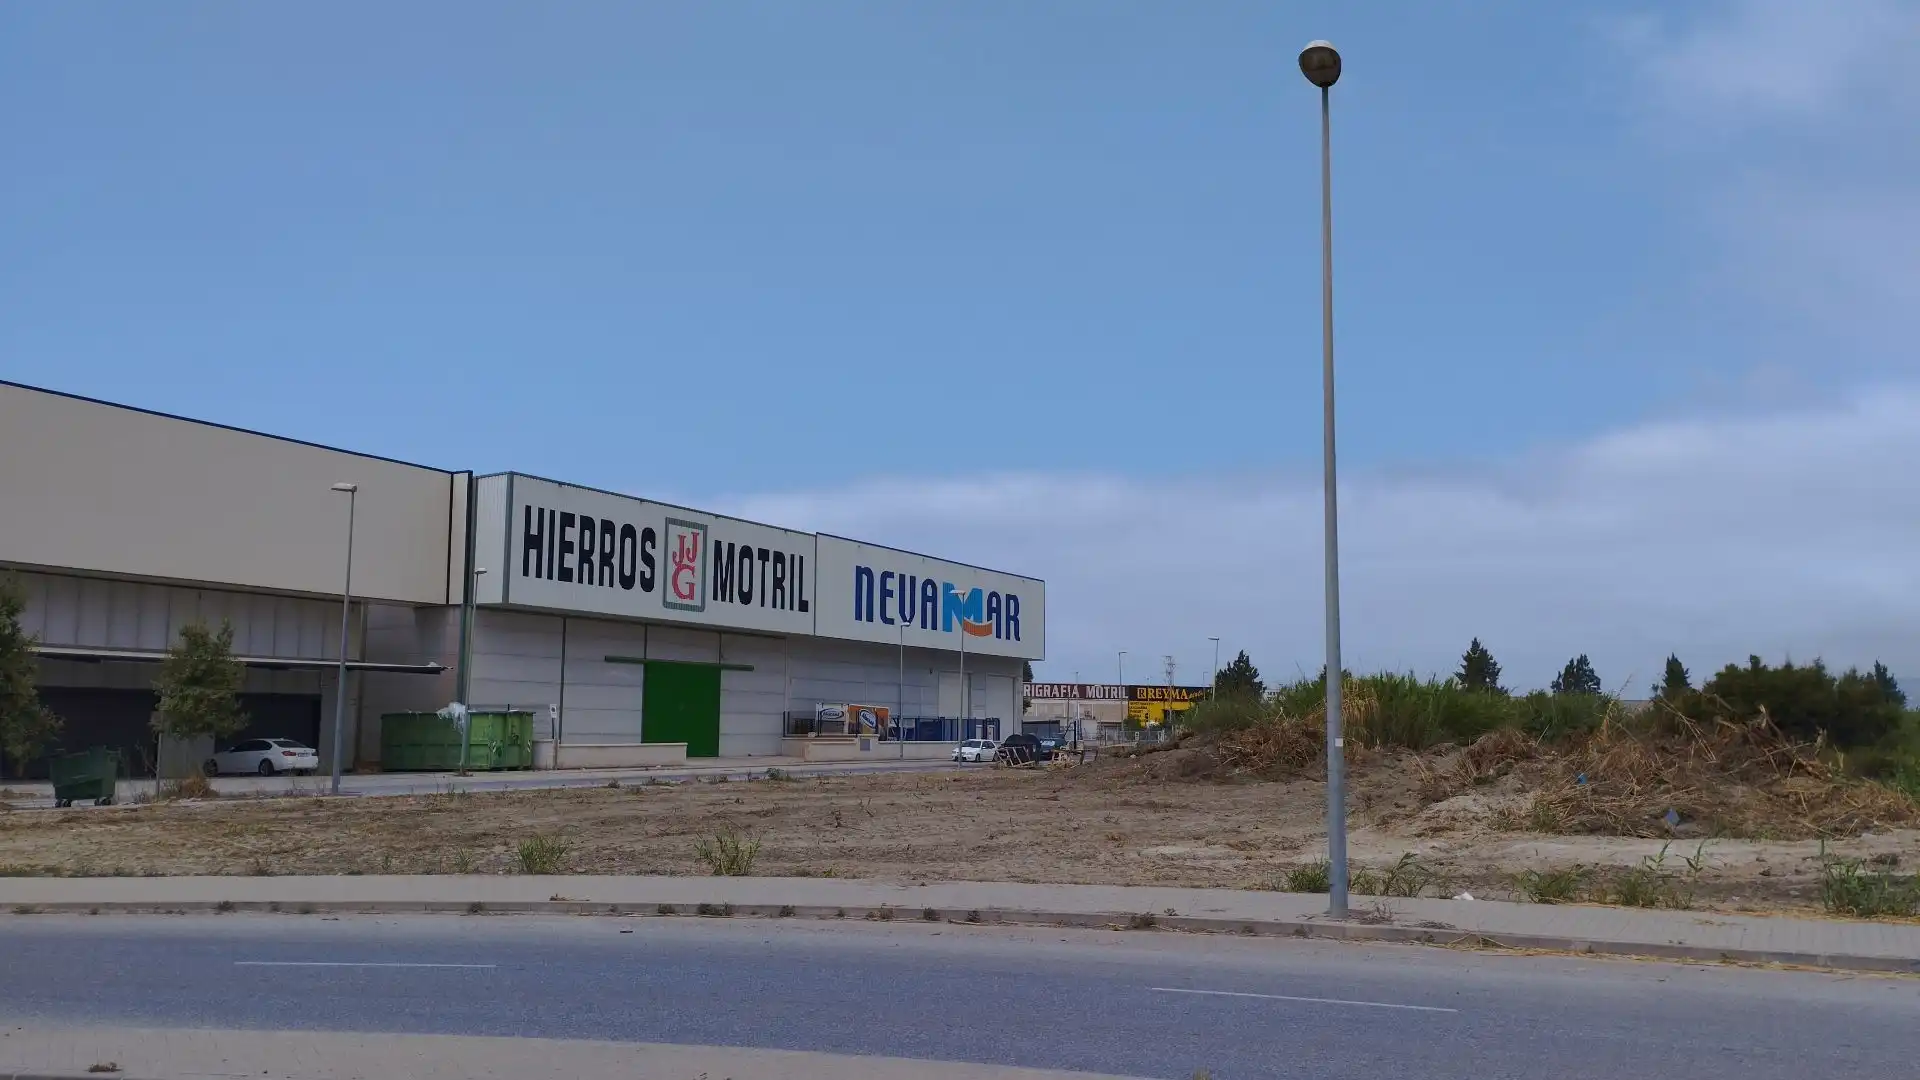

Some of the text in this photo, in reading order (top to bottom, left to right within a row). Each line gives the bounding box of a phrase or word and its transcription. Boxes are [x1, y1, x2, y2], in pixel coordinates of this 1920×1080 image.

[523, 505, 656, 592] HIERROS
[712, 539, 809, 612] MOTRIL
[855, 565, 1020, 641] NEVAMAR
[1086, 685, 1129, 699] MOTRIL
[1148, 687, 1189, 699] REYMA
